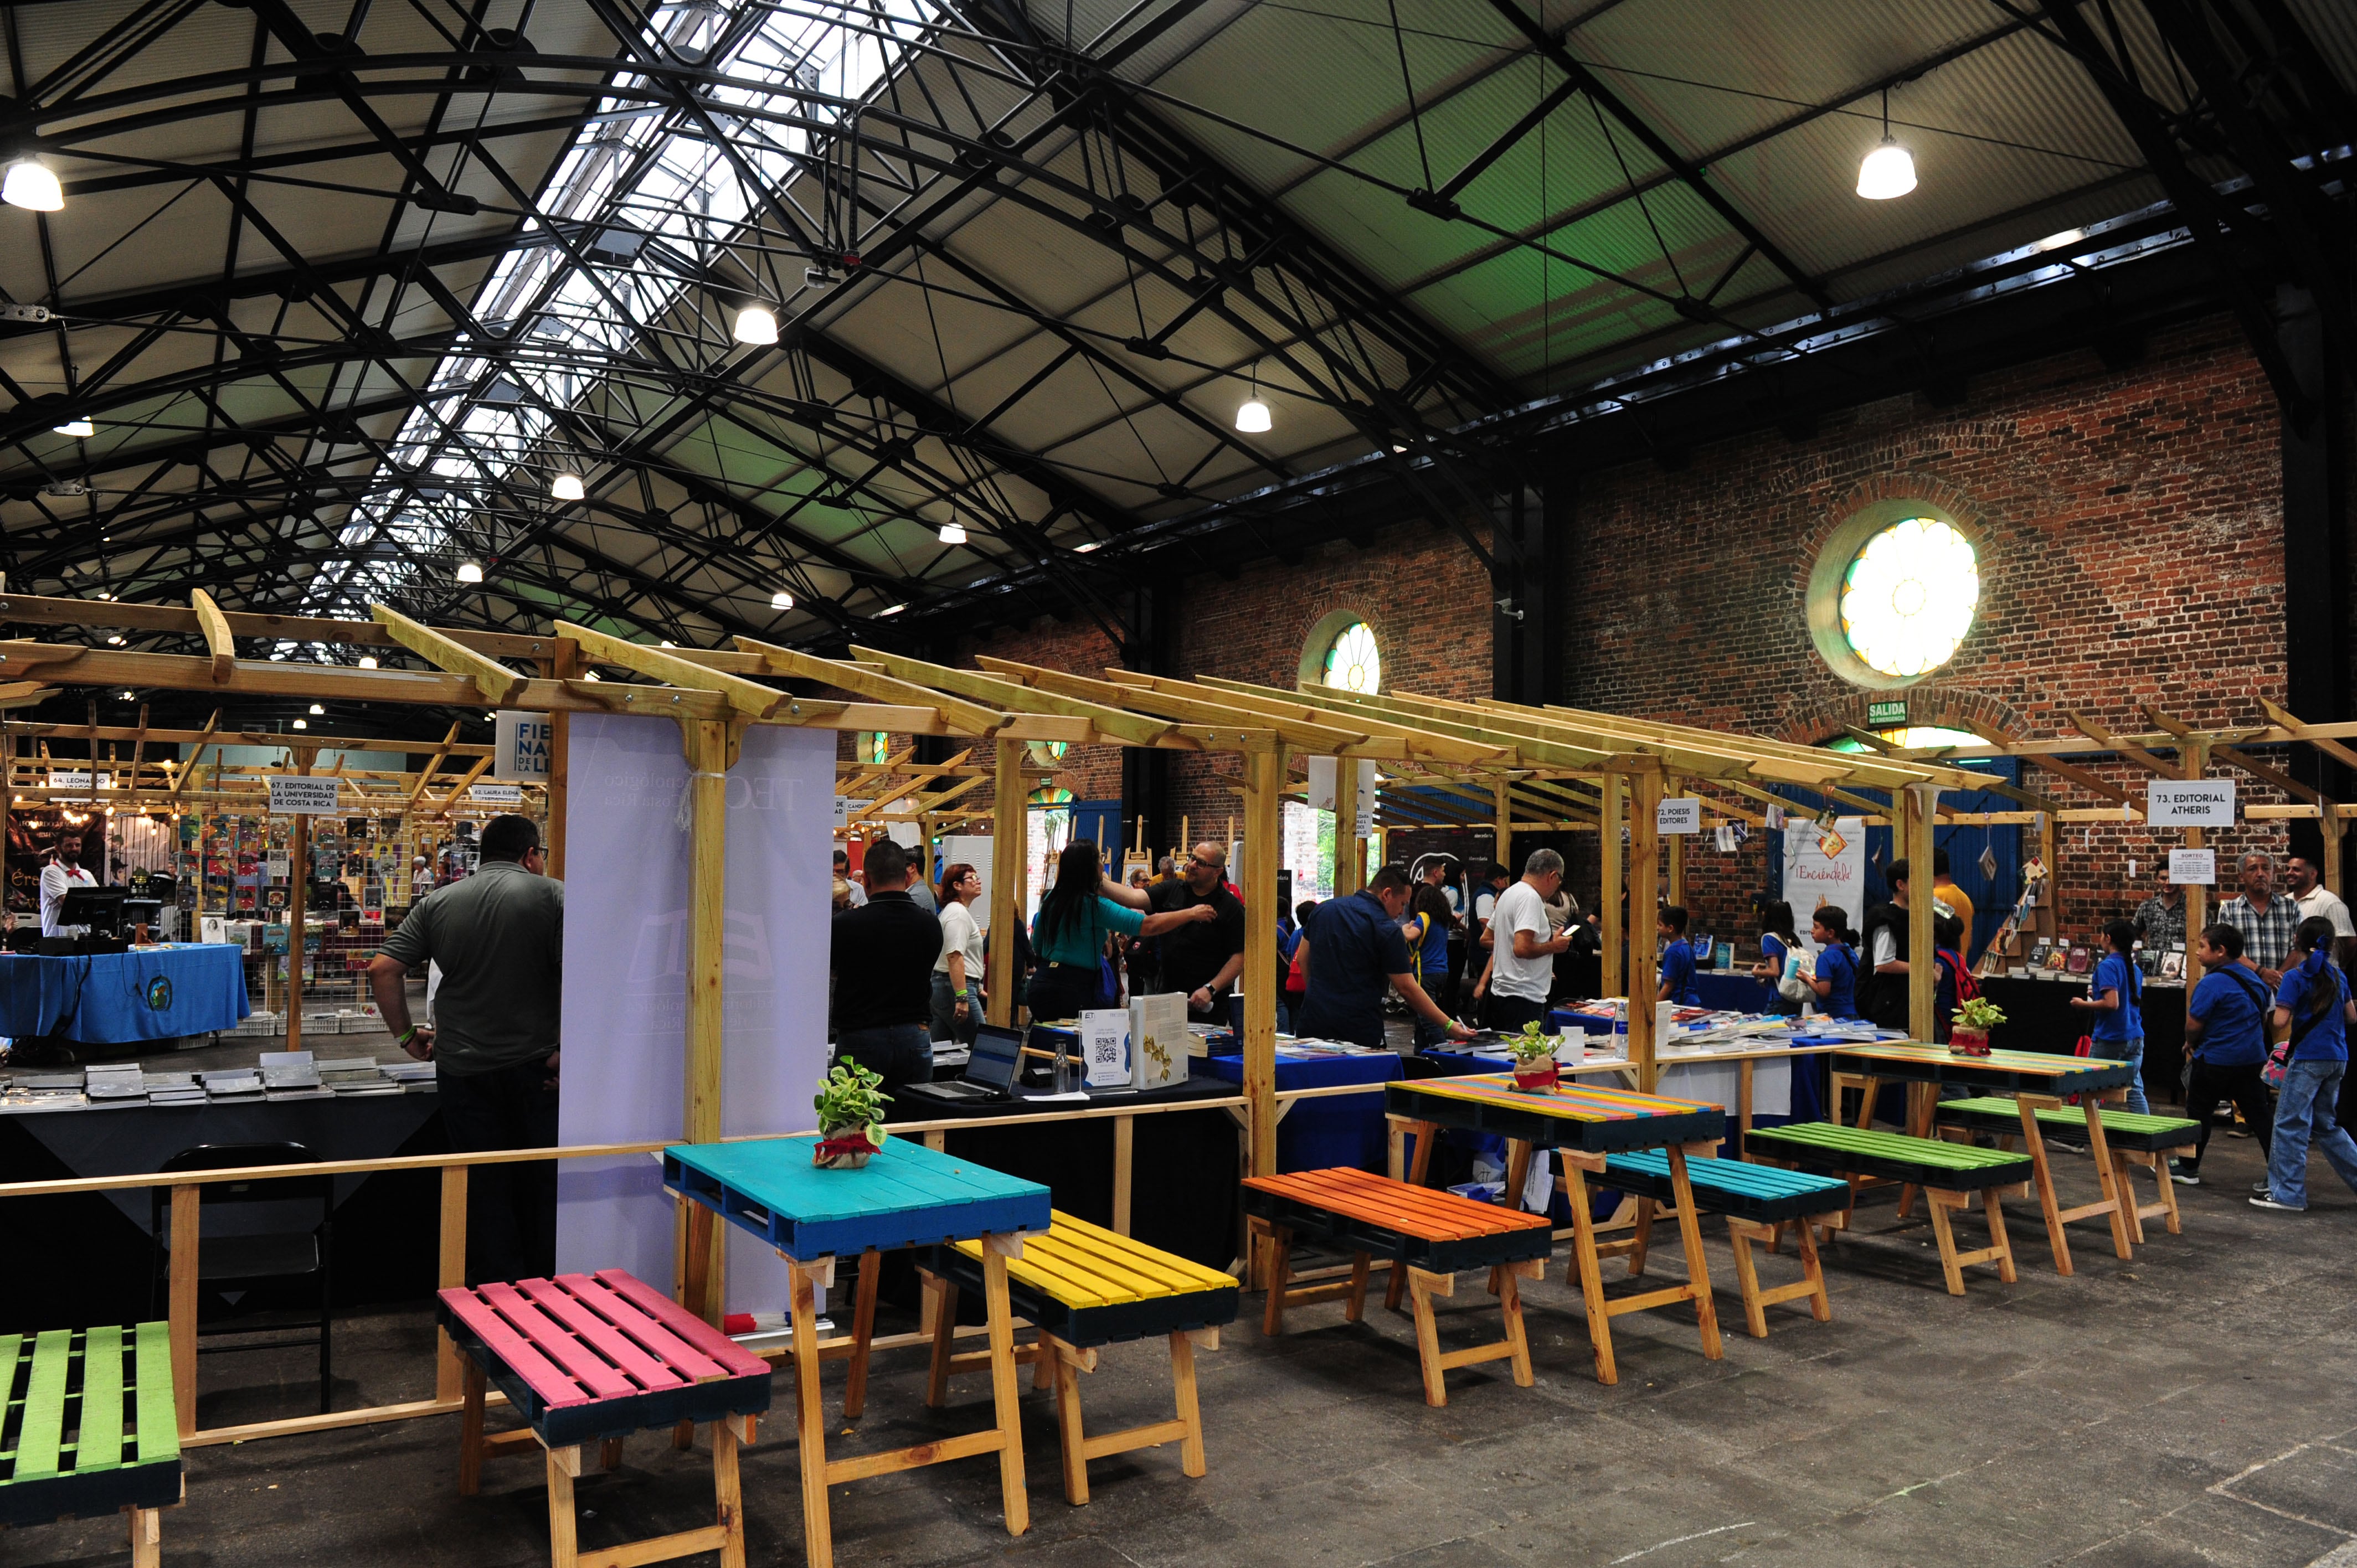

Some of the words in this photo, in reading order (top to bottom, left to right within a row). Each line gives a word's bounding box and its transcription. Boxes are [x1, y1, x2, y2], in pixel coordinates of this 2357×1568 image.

[1869, 703, 1906, 717] SALIDA
[519, 723, 550, 740] FIE
[285, 782, 324, 791] EDITORIAL
[284, 791, 334, 799] UNIVERSIDAD
[2156, 795, 2171, 803] 73.
[2174, 793, 2226, 803] EDITORIAL
[2171, 806, 2211, 814] ATHERIS
